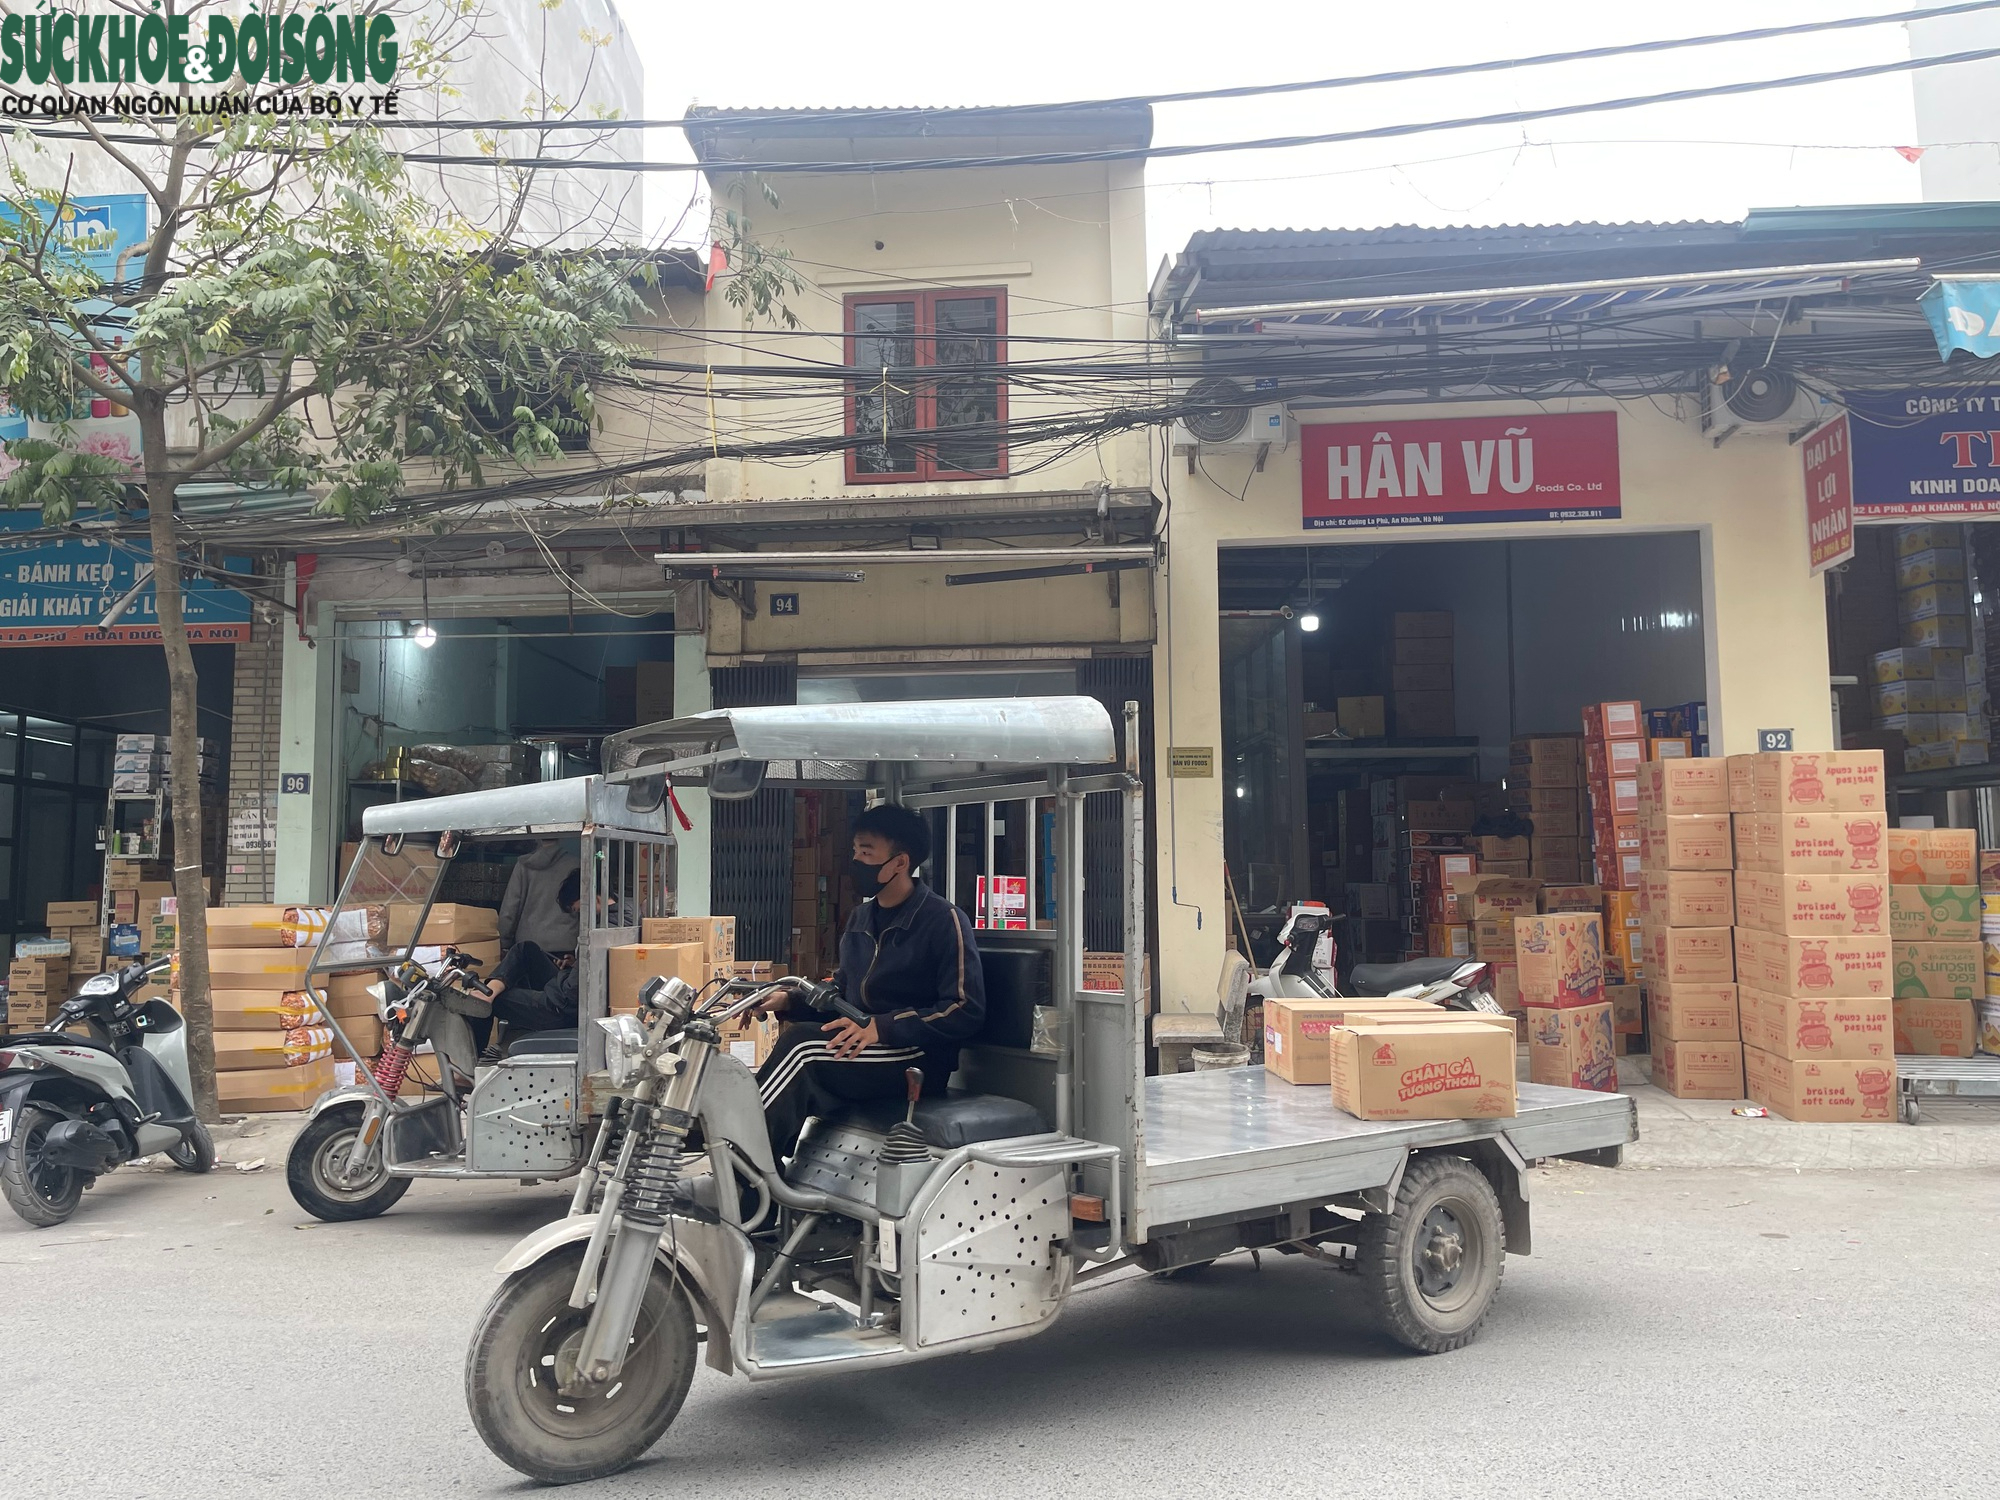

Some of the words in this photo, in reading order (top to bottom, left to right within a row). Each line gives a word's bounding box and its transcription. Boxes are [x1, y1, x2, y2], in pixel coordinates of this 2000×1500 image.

[1905, 396, 1958, 415] CÔNG
[1964, 397, 1985, 412] TY
[1806, 439, 1827, 471] ĐẠI
[1829, 425, 1843, 457] LÝ
[1326, 431, 1443, 500] HÂN
[1461, 426, 1535, 495] VŨ
[1535, 483, 1565, 493] Foods
[1566, 483, 1585, 492] Co.
[1587, 482, 1603, 491] Ltd
[1817, 472, 1837, 504] LỢI
[1909, 479, 1957, 495] KINH
[1868, 505, 1881, 514] LA
[1911, 503, 1926, 512] AN
[1970, 501, 1984, 511] HÀ
[1338, 517, 1347, 526] 92
[1391, 516, 1400, 524] An
[1811, 506, 1848, 545] NHÀN
[1841, 533, 1850, 550] 92
[18, 560, 71, 583] BÁNH
[76, 563, 114, 586] KẸO
[0, 592, 37, 617] GIẢI
[43, 593, 93, 616] KHÁT
[776, 597, 793, 612] 94
[209, 628, 239, 641] NỘI
[1766, 733, 1786, 749] 92
[1826, 767, 1852, 775] candy
[1857, 765, 1878, 773] soft
[287, 777, 304, 792] 96
[1836, 776, 1874, 785] braised
[1795, 838, 1834, 847] braised
[1790, 849, 1812, 857] soft
[1817, 848, 1845, 858] candy
[1922, 849, 1970, 859] BISCUITS
[1945, 860, 1971, 869] EGG
[1797, 902, 1837, 911] braised
[1819, 912, 1846, 921] candy
[1834, 952, 1861, 961] candy
[1866, 951, 1886, 960] soft
[1845, 961, 1882, 971] braised
[1921, 962, 1976, 972] BISCUITS
[1947, 973, 1976, 982] EGG
[1834, 1014, 1861, 1022] candy
[1866, 1014, 1887, 1022] soft
[1844, 1024, 1882, 1032] braised
[1906, 1018, 1962, 1029] BISCUITS
[1933, 1030, 1963, 1040] EGG
[1401, 1062, 1446, 1087] CHÂN
[1448, 1056, 1475, 1077] GÀ
[1806, 1087, 1845, 1096] braised
[1802, 1097, 1823, 1105] soft
[1828, 1097, 1855, 1106] candy
